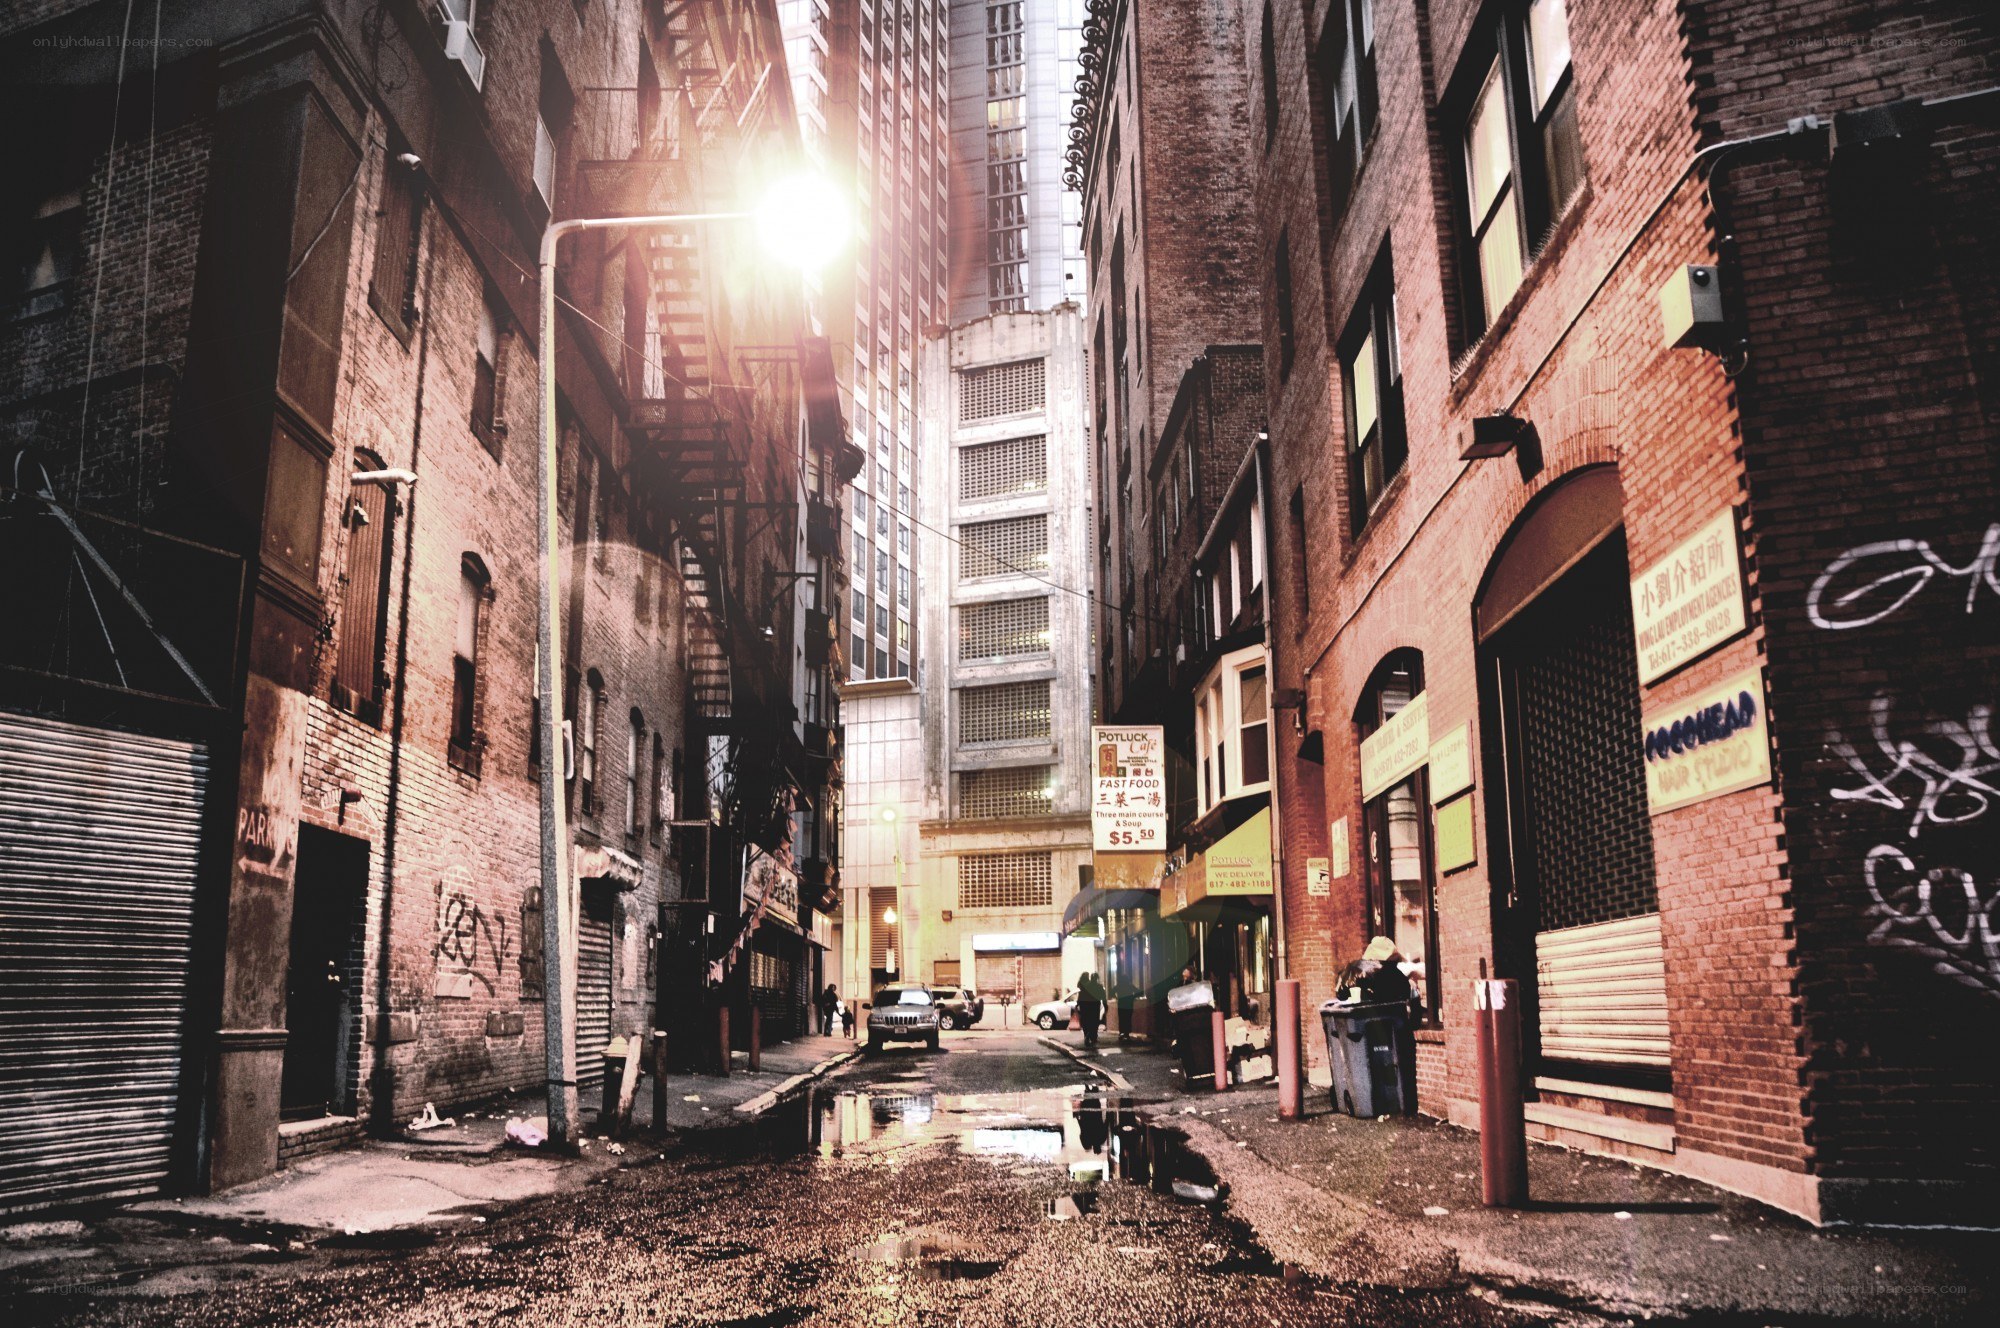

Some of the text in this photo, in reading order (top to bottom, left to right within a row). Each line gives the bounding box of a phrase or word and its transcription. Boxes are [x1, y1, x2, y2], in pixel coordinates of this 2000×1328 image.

[1665, 593, 1706, 636] EMPLOYMENT
[1706, 573, 1738, 610] AGENCIES
[1098, 731, 1148, 742] POTLUCK
[1099, 779, 1159, 788] FAST FOOD
[1096, 791, 1161, 808] 三菜一湯
[238, 807, 298, 854] PARKG
[1122, 819, 1142, 828] Soup
